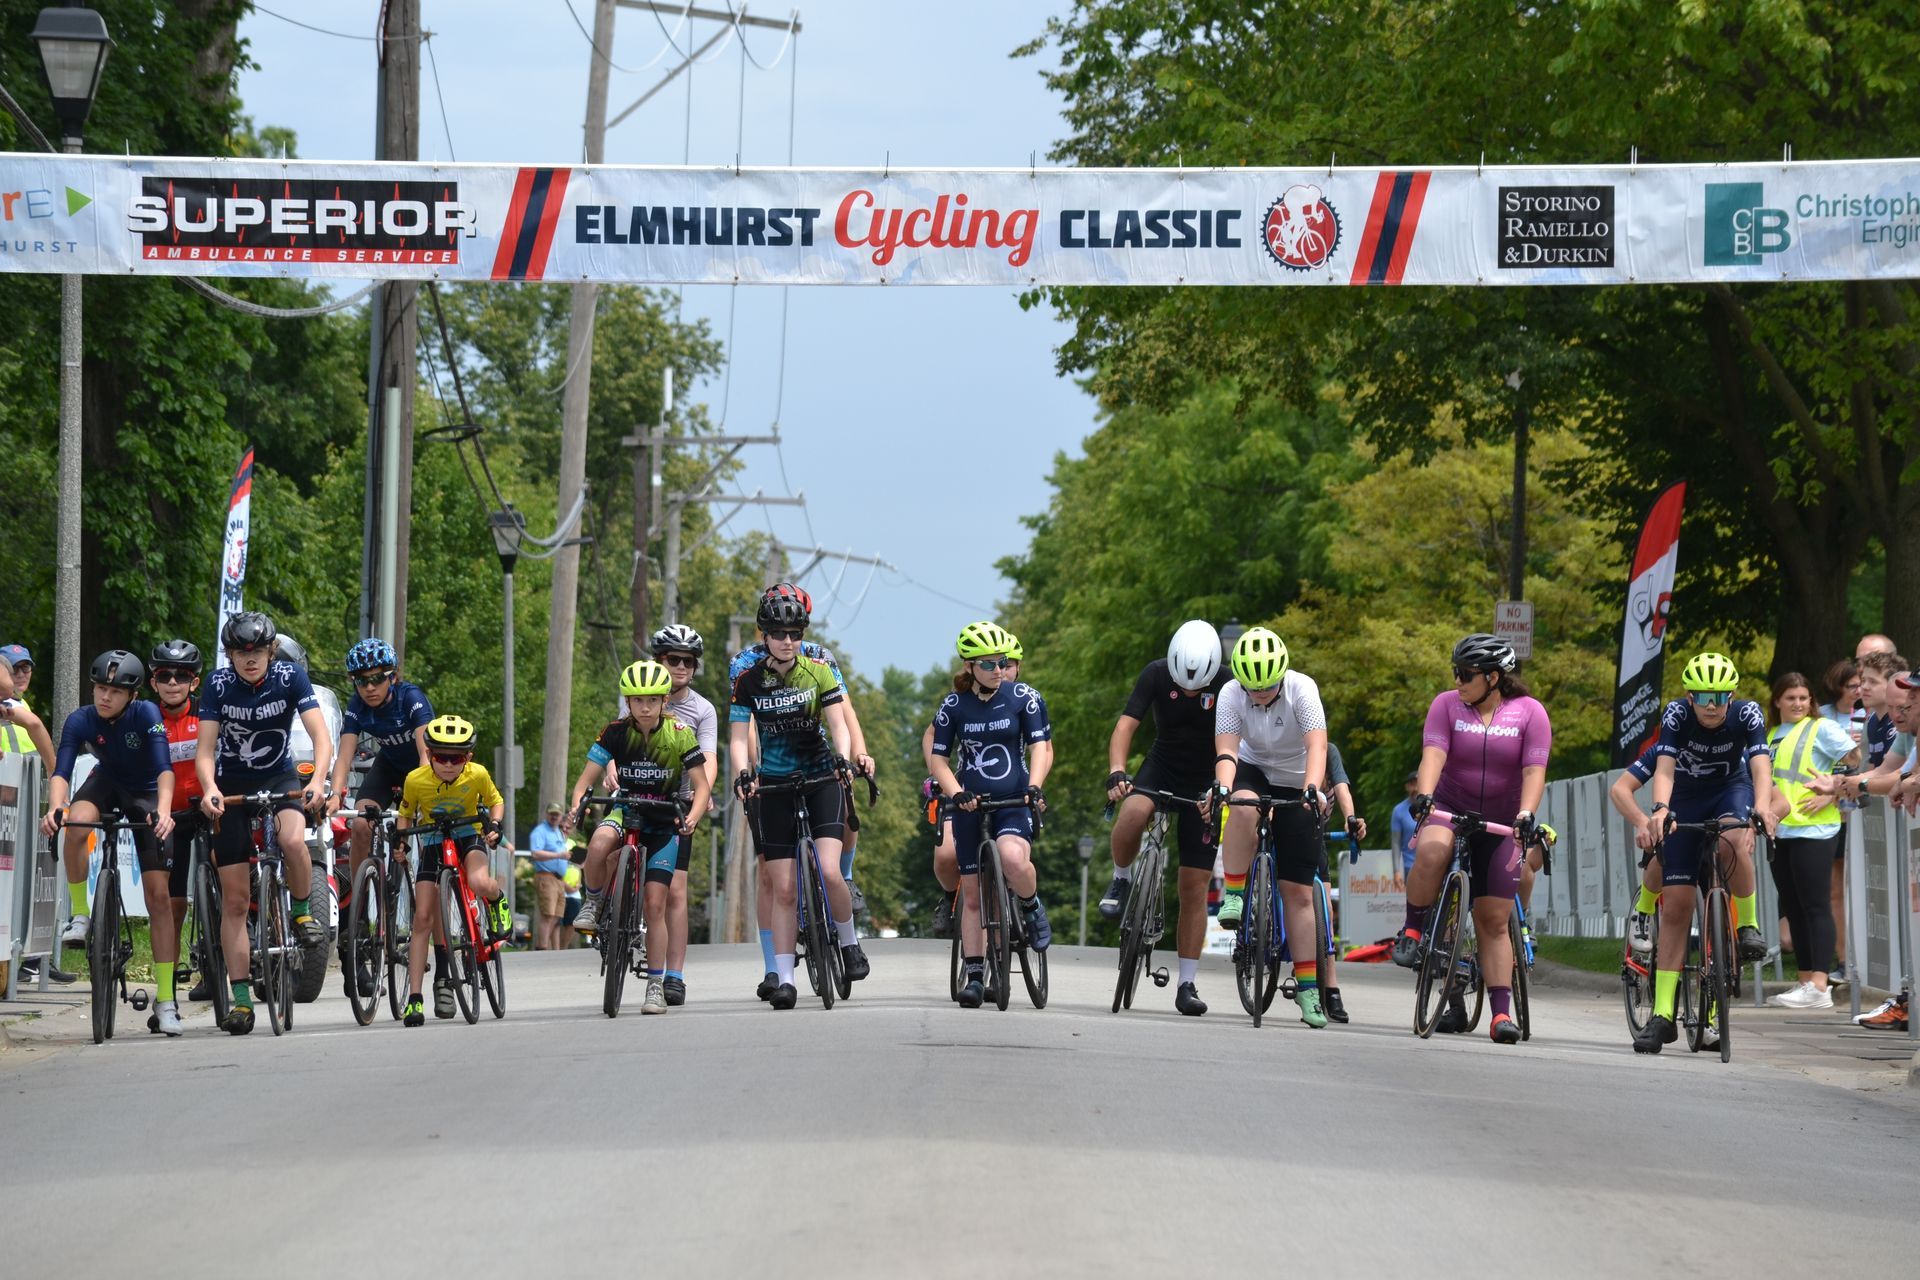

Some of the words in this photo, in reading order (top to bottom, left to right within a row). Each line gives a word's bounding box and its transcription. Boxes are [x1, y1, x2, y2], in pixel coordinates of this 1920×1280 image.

[1505, 191, 1601, 213] STORINO
[127, 196, 477, 239] SUPERIOR
[575, 205, 820, 247] ELMHURST
[834, 189, 1040, 268] Cycling
[1059, 208, 1242, 249] CLASSIC
[1505, 217, 1609, 238] RAMELLO
[148, 247, 312, 261] AMBULANCE
[337, 249, 452, 263] SERVICE
[1507, 607, 1521, 618] NO
[1497, 621, 1530, 632] PARKING
[754, 687, 817, 710] VELOSPORT
[221, 704, 253, 721] PONY
[255, 699, 287, 720] SHOP
[964, 723, 986, 733] PONY
[988, 719, 1011, 731] SHOP
[1688, 740, 1710, 753] PONY
[1712, 741, 1734, 753] SHOP
[618, 767, 675, 779] VELOSPORT
